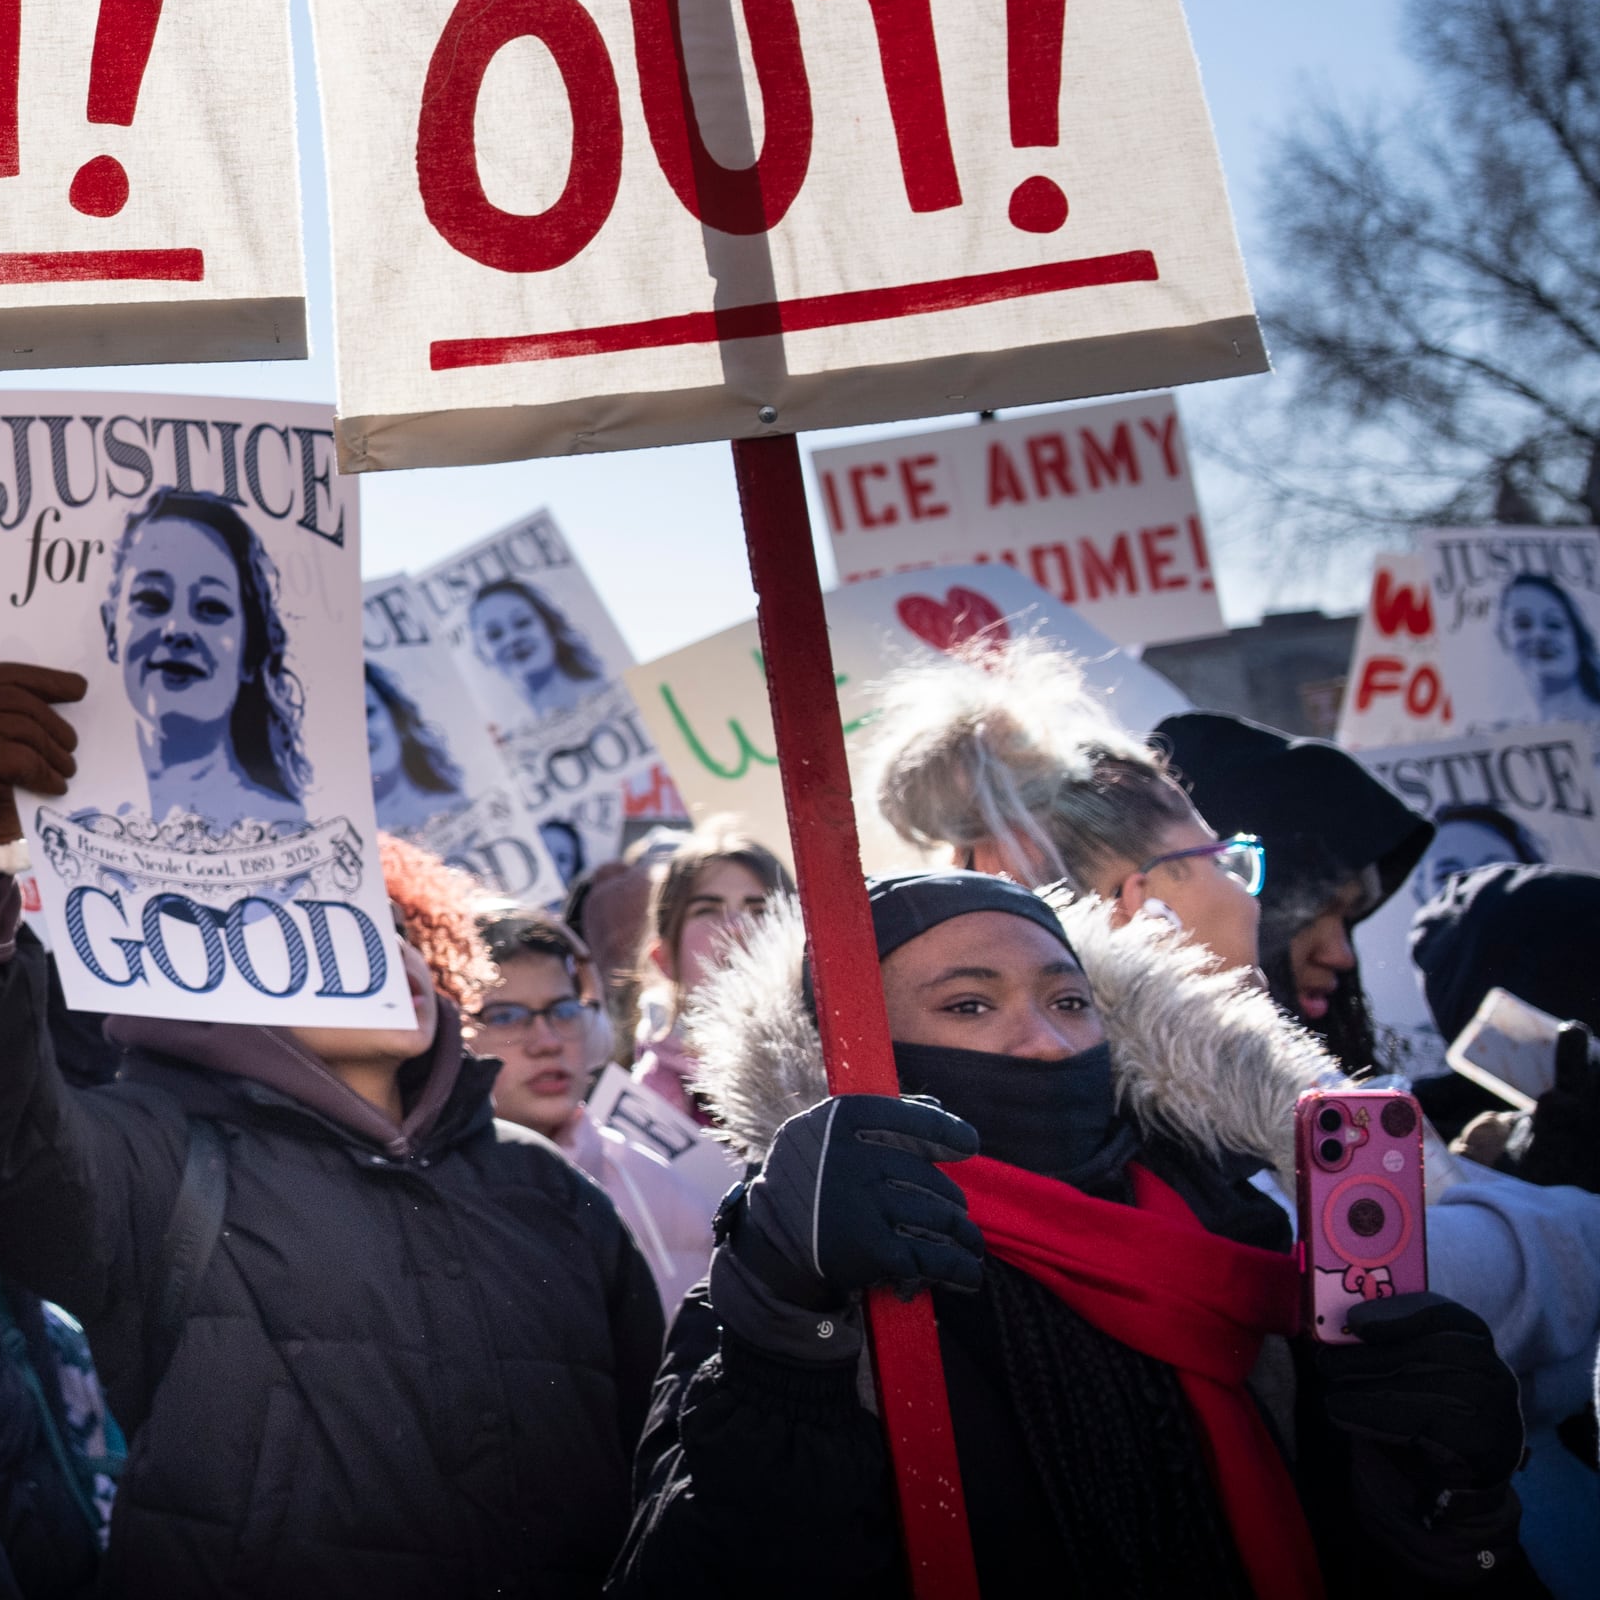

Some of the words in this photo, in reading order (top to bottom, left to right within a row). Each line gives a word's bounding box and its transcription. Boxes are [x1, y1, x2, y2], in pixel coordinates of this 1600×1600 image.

[822, 453, 950, 534] ICE
[986, 412, 1181, 508] ARMY
[9, 506, 104, 607] for
[976, 513, 1215, 606] OME!
[1373, 739, 1597, 821] STICE
[65, 885, 388, 999] GOOD
